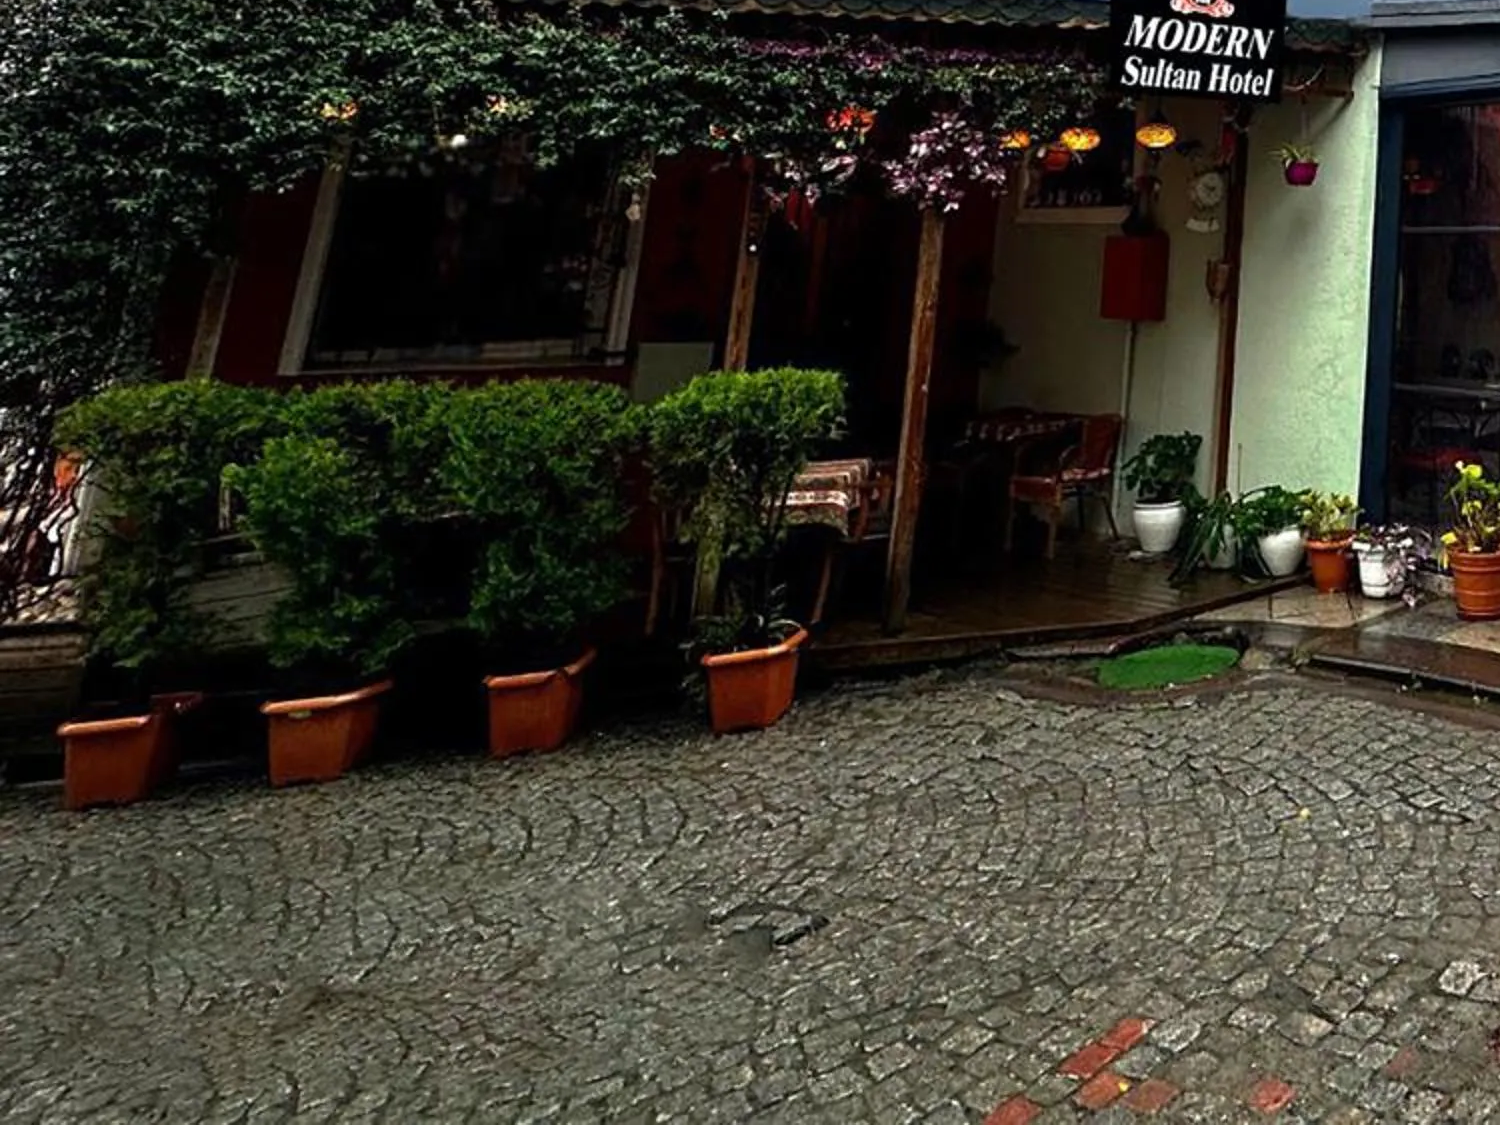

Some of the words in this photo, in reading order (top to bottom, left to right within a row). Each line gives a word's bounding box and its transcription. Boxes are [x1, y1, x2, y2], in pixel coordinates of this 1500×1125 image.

[1124, 15, 1275, 60] MODERN
[1121, 56, 1201, 91] Sultan
[1207, 64, 1274, 97] Hotel
